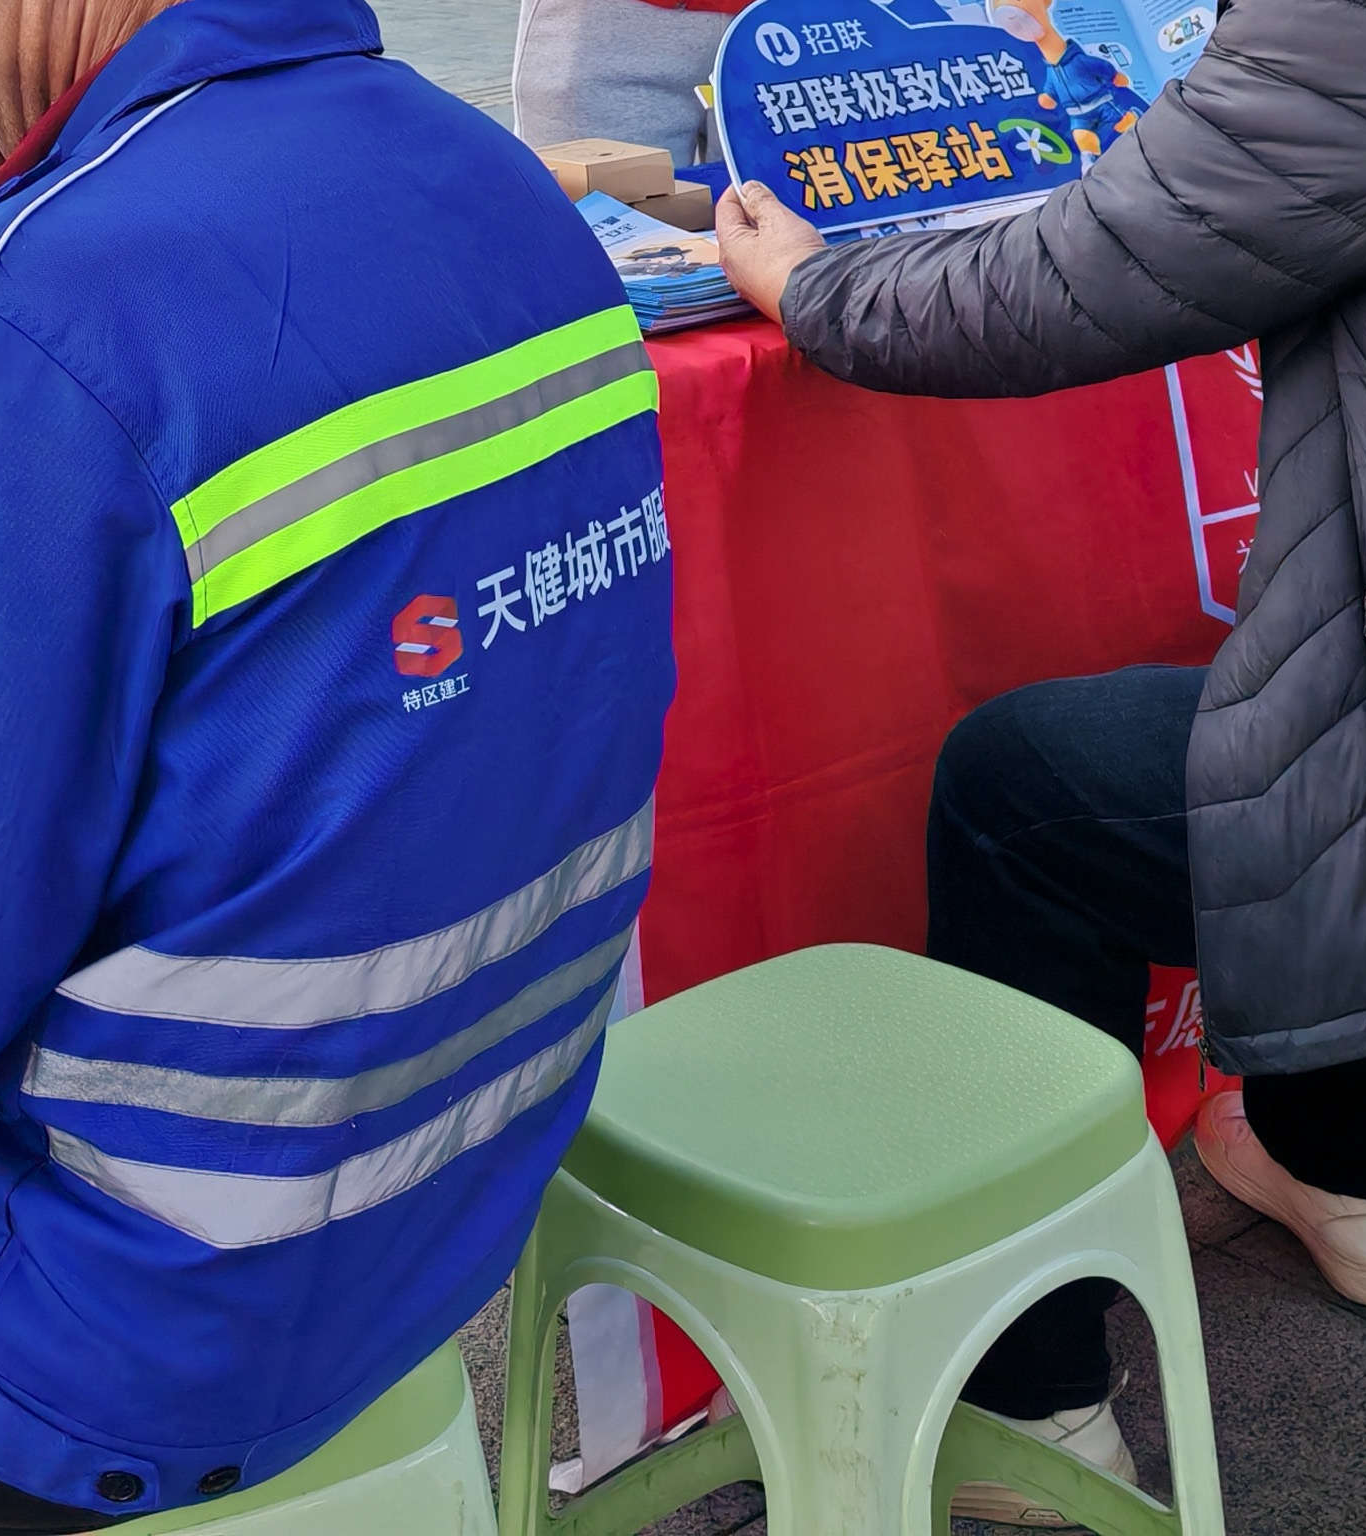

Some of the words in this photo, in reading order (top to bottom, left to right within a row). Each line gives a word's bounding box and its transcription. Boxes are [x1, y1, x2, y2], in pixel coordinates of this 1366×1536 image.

[800, 18, 873, 58] 招联
[755, 50, 1037, 136] 招联极致体验
[784, 121, 1013, 211] 消保驿站
[402, 673, 471, 713] 特区建工
